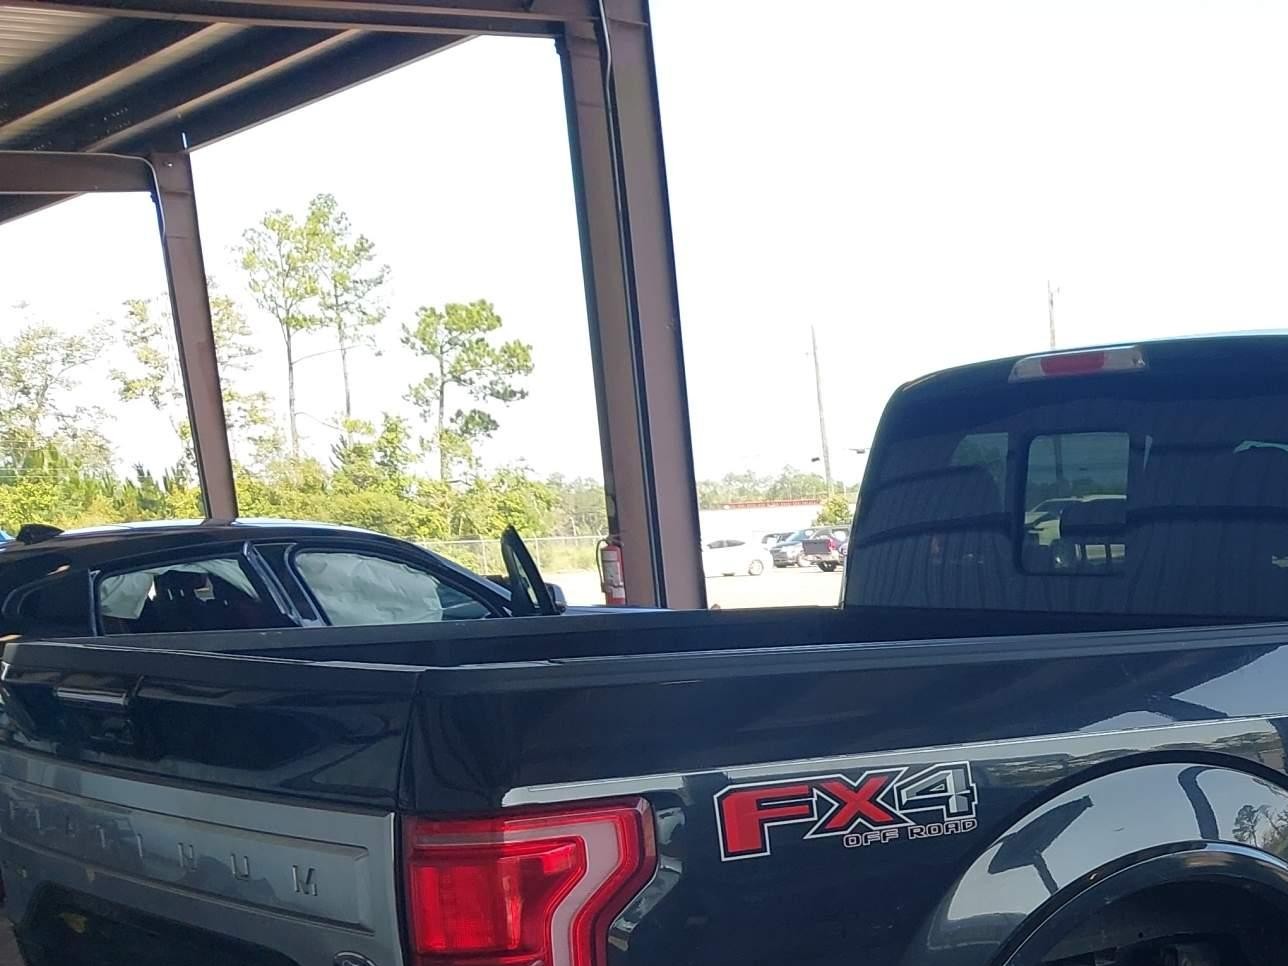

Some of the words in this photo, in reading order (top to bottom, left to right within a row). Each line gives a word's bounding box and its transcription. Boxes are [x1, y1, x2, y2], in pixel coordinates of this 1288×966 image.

[714, 761, 979, 862] FX4
[843, 828, 899, 849] OFF
[908, 818, 979, 841] ROAD
